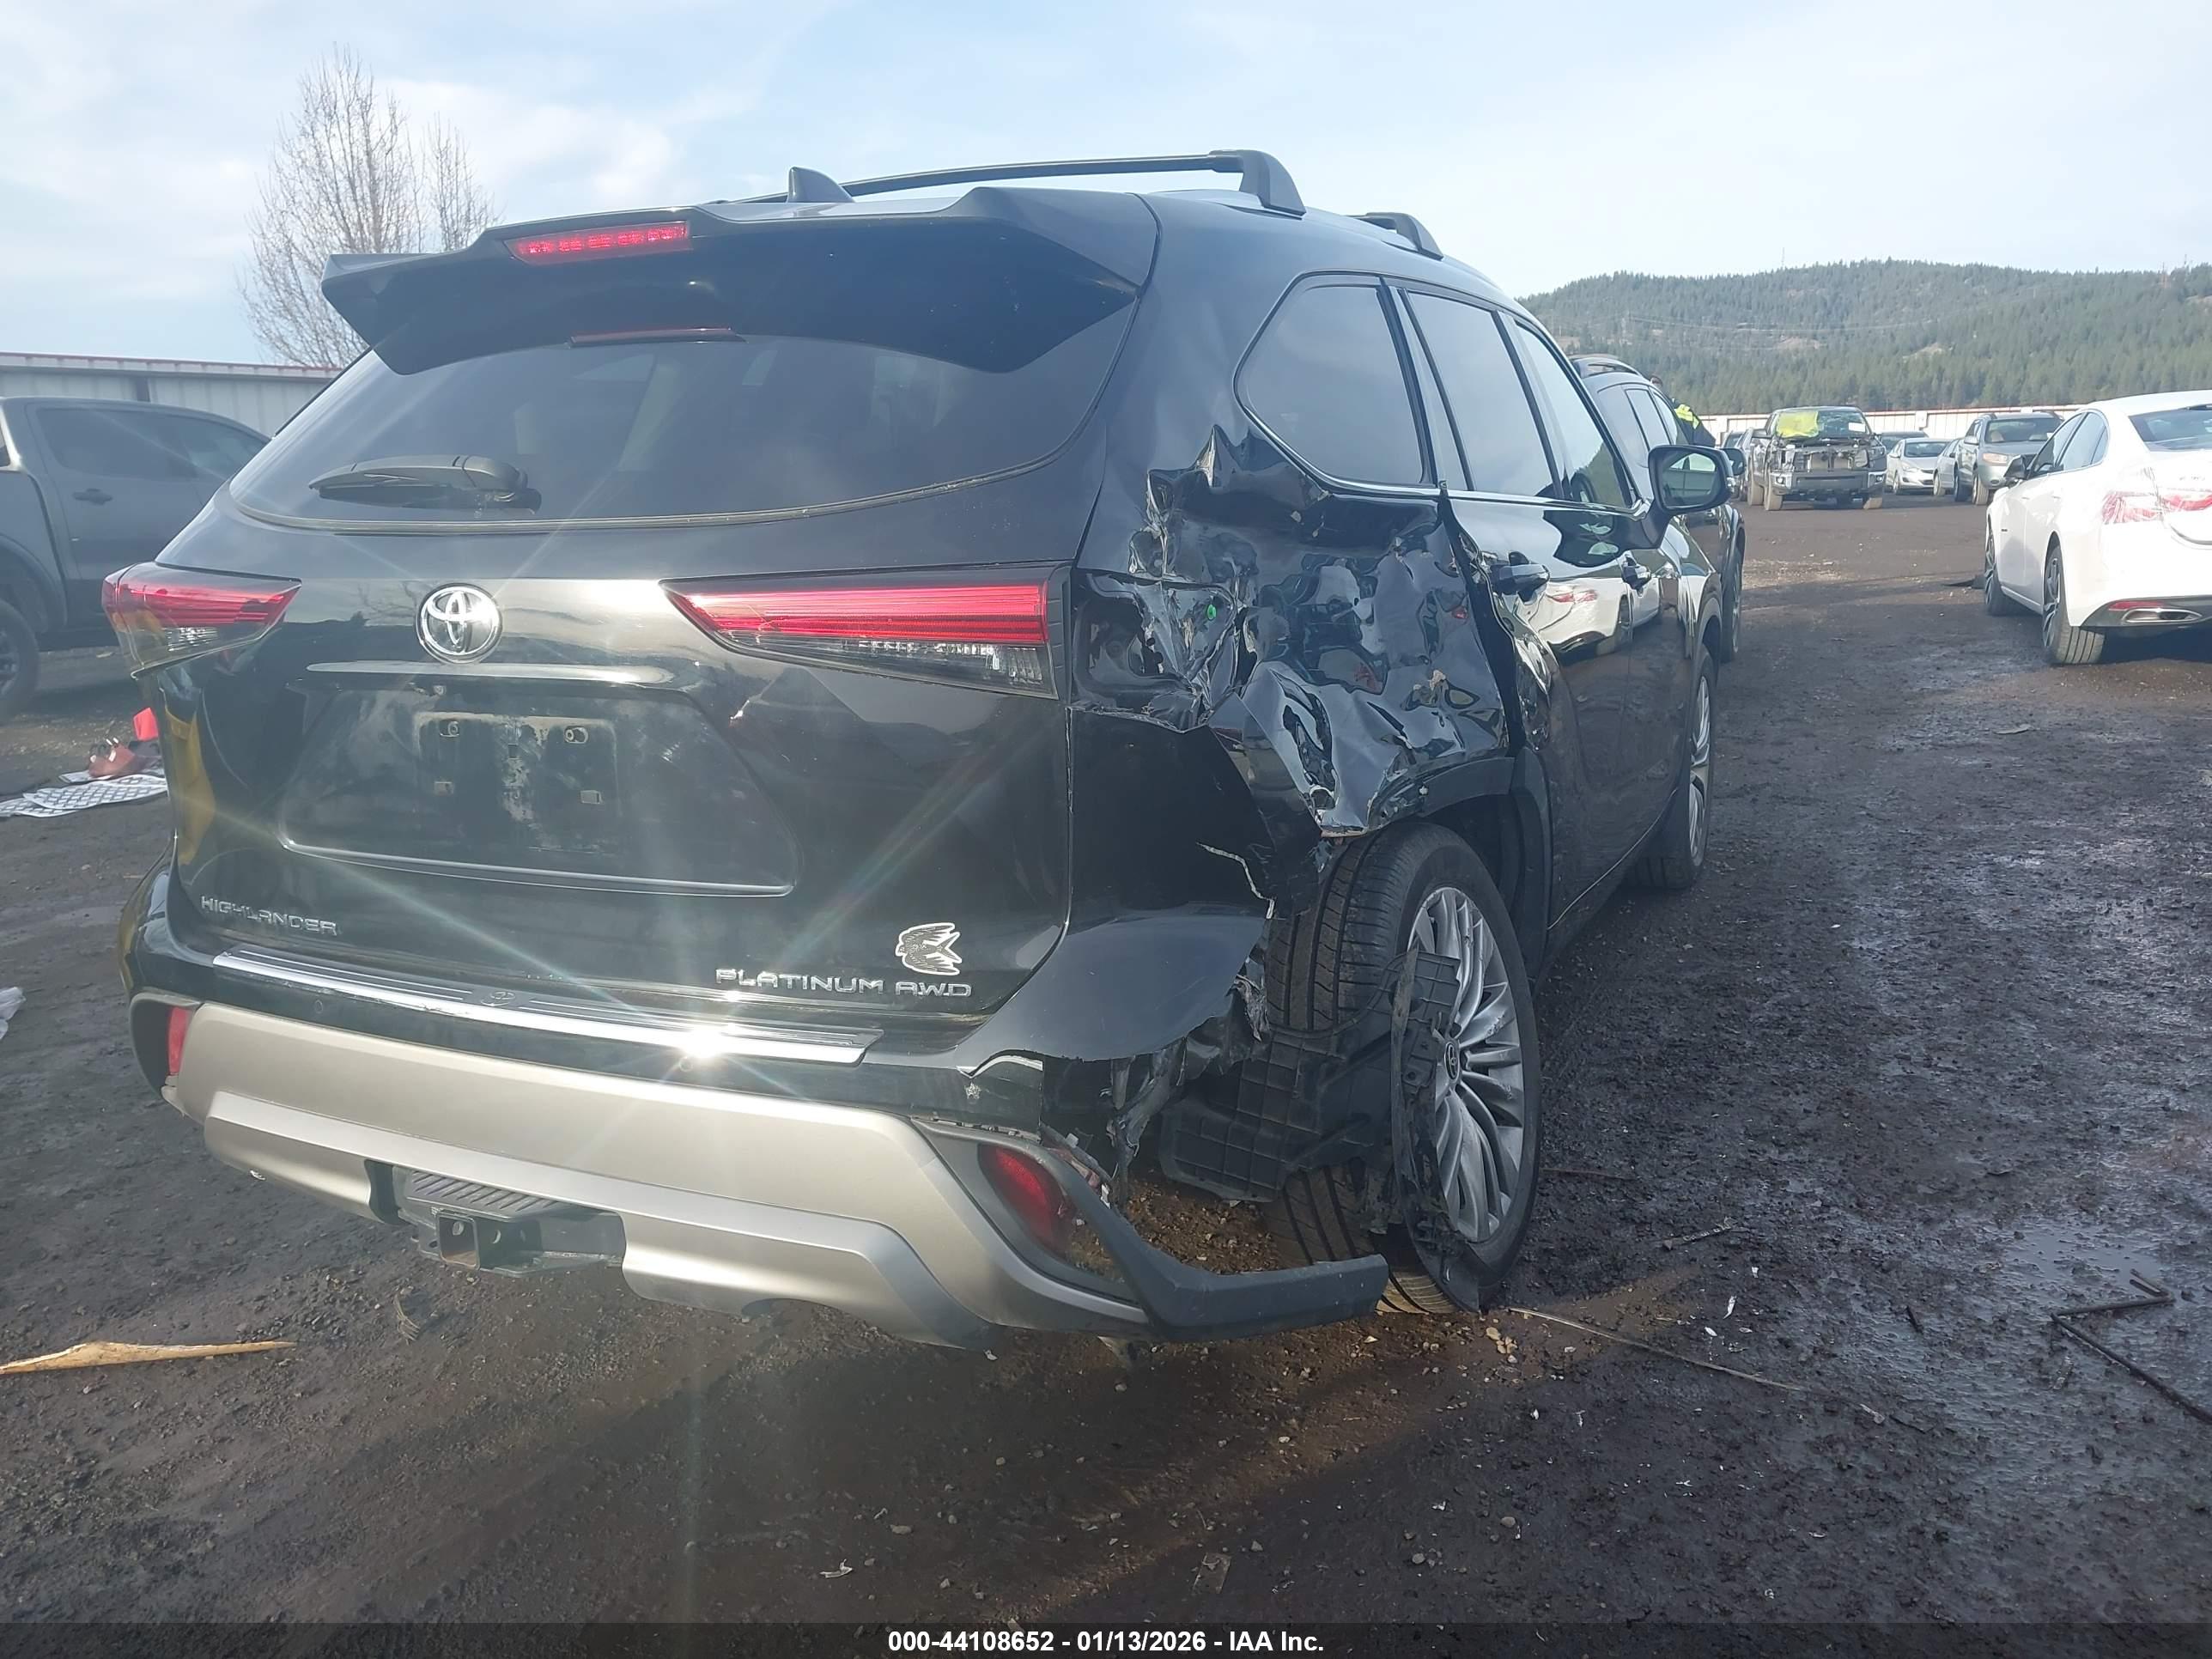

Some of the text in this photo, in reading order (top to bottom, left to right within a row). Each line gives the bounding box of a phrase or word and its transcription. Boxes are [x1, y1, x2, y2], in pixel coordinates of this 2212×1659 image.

[200, 896, 338, 936] HIGHLANDER
[715, 968, 972, 998] PLATINUM AWD
